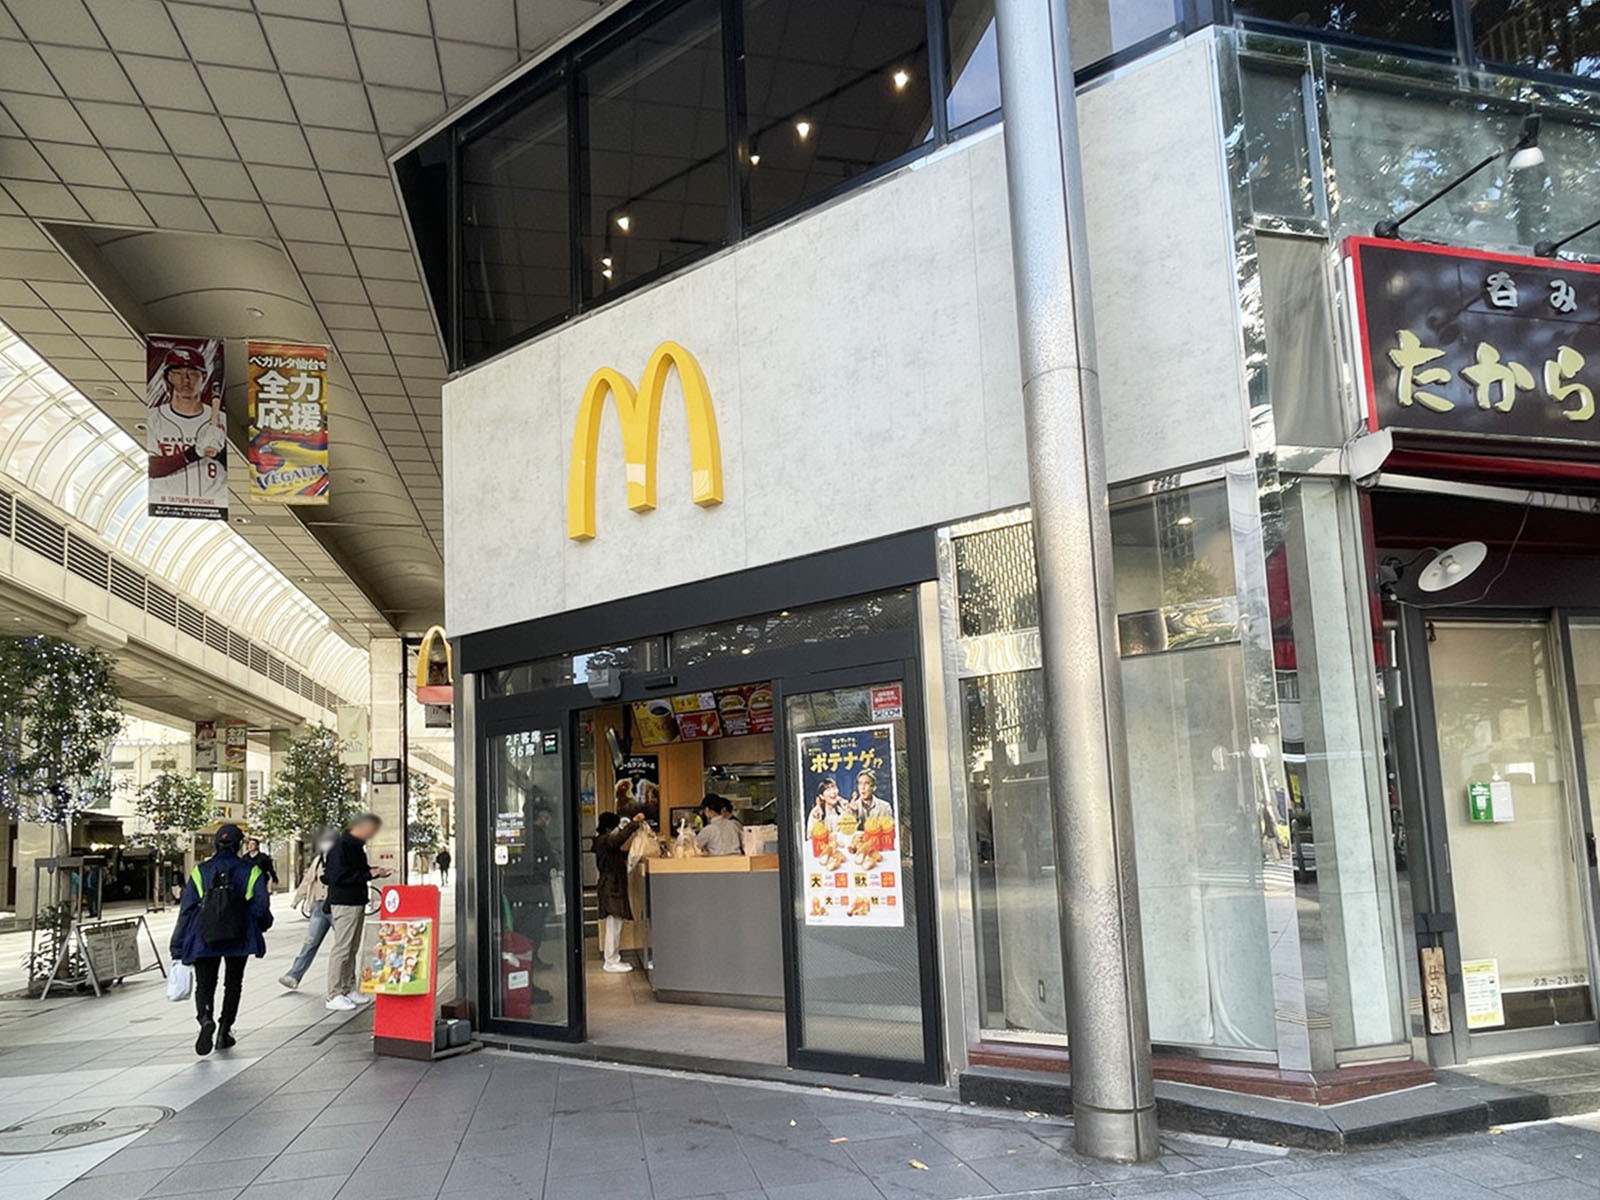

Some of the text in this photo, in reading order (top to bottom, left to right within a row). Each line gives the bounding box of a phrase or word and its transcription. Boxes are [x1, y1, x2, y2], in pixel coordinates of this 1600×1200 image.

[1388, 329, 1595, 421] たから
[257, 370, 321, 402] 全力
[256, 400, 323, 433] 応援
[207, 462, 217, 479] 8
[505, 730, 541, 746] 2F客席
[509, 743, 535, 758] 96席
[811, 876, 822, 888] 大
